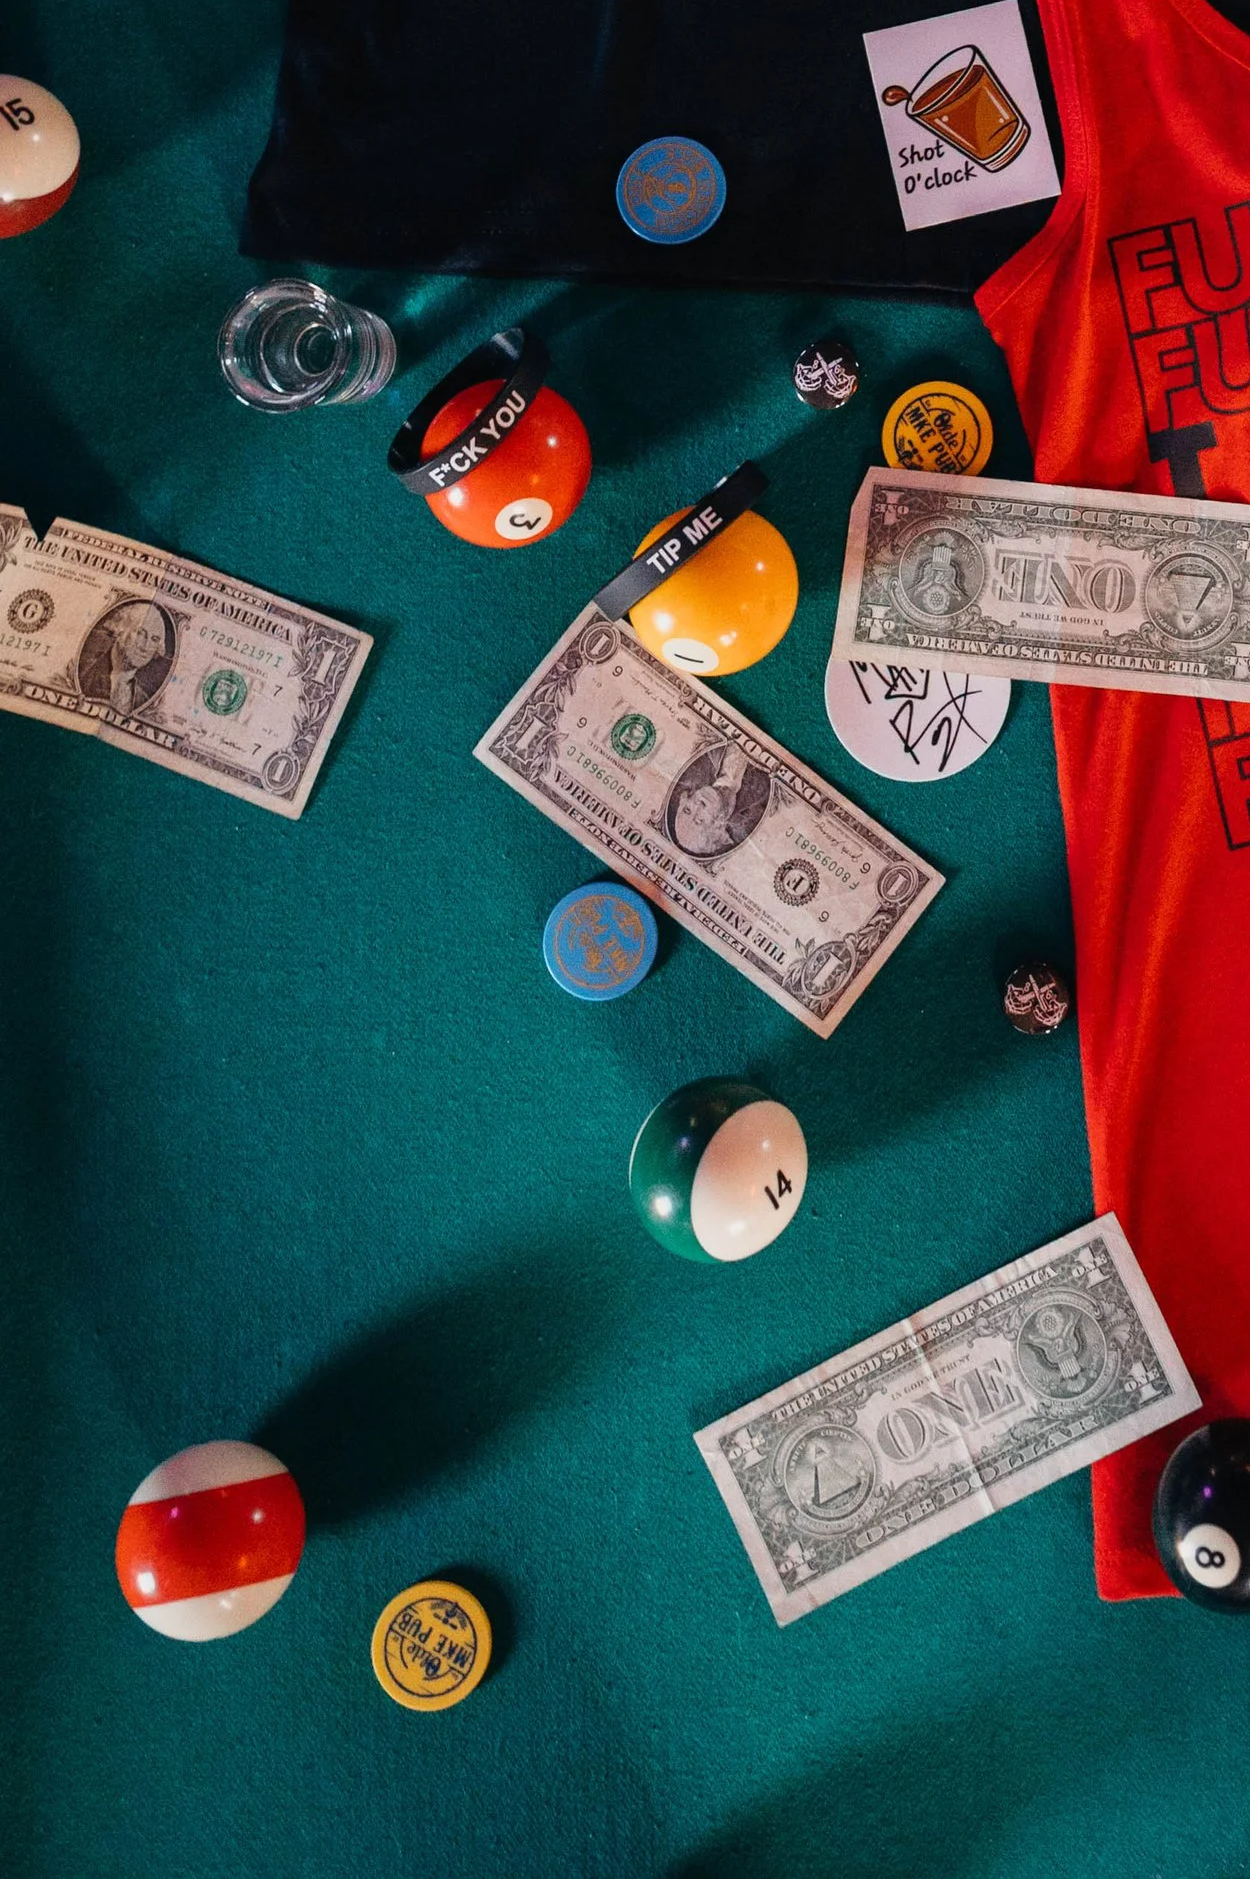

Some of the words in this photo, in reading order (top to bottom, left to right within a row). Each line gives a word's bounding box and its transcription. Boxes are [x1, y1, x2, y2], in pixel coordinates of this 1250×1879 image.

[0, 97, 36, 132] 15
[898, 139, 945, 168] Shot
[904, 160, 978, 194] O'clock
[479, 389, 526, 442] YOU
[905, 406, 937, 443] MKE
[646, 538, 683, 576] TIP
[681, 506, 724, 547] ME
[24, 536, 60, 556] THE
[61, 543, 126, 575] UNITED
[128, 567, 191, 600] STATES
[190, 592, 217, 613] OF
[210, 599, 292, 643] AMERICA
[997, 550, 1137, 613] ONE
[906, 633, 998, 655] AMERICA
[1019, 644, 1093, 666] STATES
[1094, 652, 1166, 672] UNITED
[1168, 659, 1209, 677] THE
[25, 684, 79, 712] ONE
[82, 700, 177, 750] DOLLAR
[691, 695, 777, 772] DOLLAR
[554, 769, 623, 831] AMERICA
[778, 767, 823, 805] ONE
[621, 824, 644, 846] OF
[641, 841, 698, 892] STATES
[698, 886, 753, 932] UNITED
[752, 932, 787, 966] THE
[763, 1167, 793, 1211] 14
[771, 1393, 812, 1422] THE
[812, 1355, 883, 1401] UNITED
[881, 1317, 953, 1363] STATES
[975, 1264, 1058, 1318] AMERICA
[875, 1356, 1023, 1465] ONE
[1195, 1546, 1226, 1569] 8
[398, 1612, 433, 1644] PUB
[433, 1634, 472, 1668] MKE
